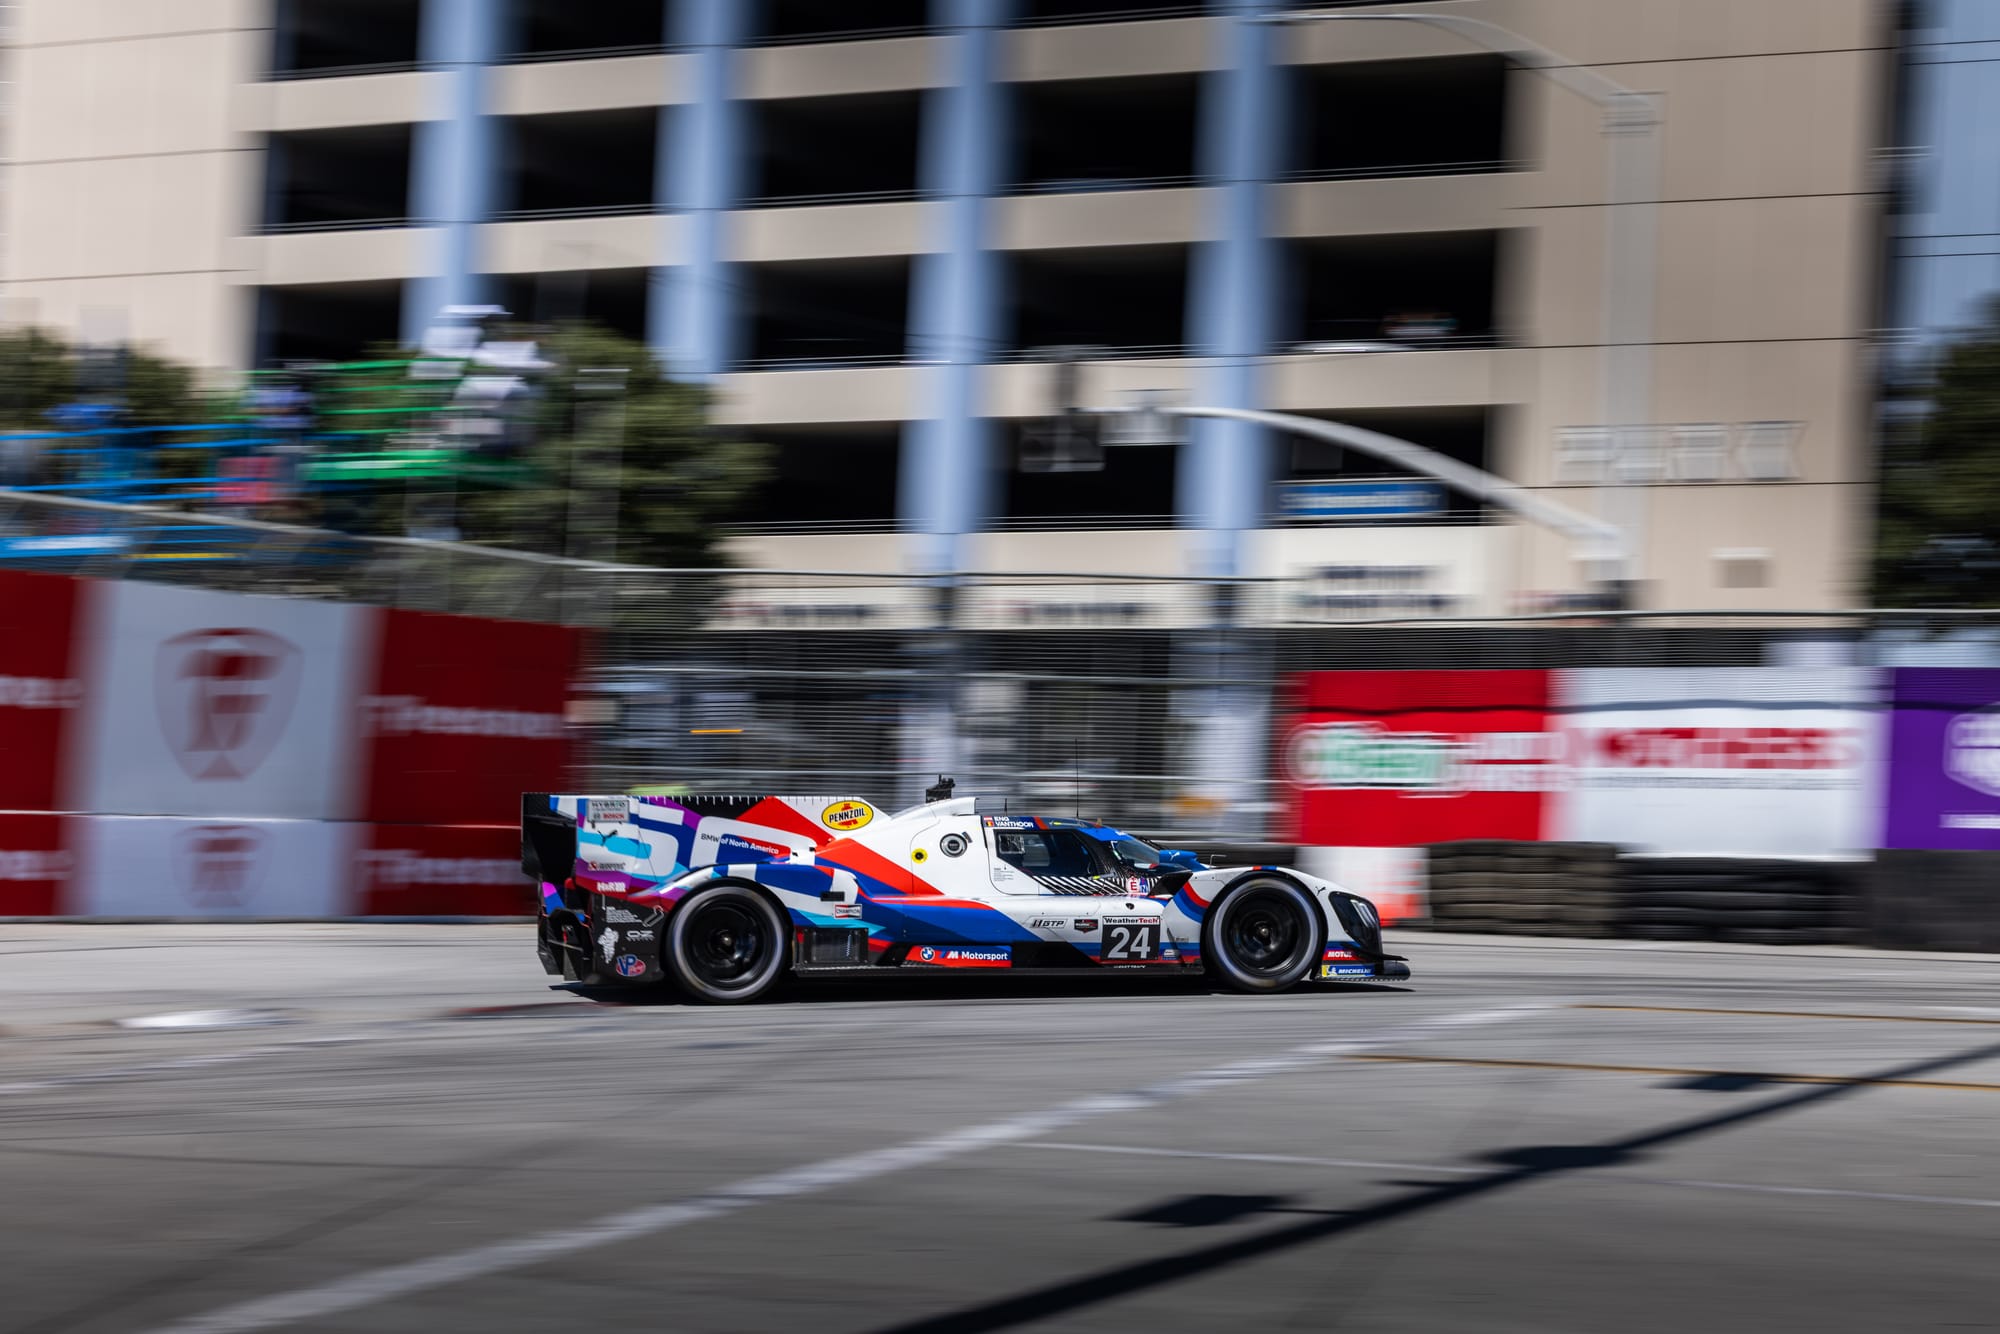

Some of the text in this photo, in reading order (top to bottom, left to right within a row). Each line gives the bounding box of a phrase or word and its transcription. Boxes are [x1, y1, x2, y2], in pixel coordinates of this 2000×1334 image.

[829, 807, 865, 823] PENNZOIL
[701, 833, 719, 842] BMW
[729, 839, 749, 849] North
[750, 842, 779, 855] America
[1107, 927, 1151, 959] 24
[961, 950, 1008, 960] Motorsport
